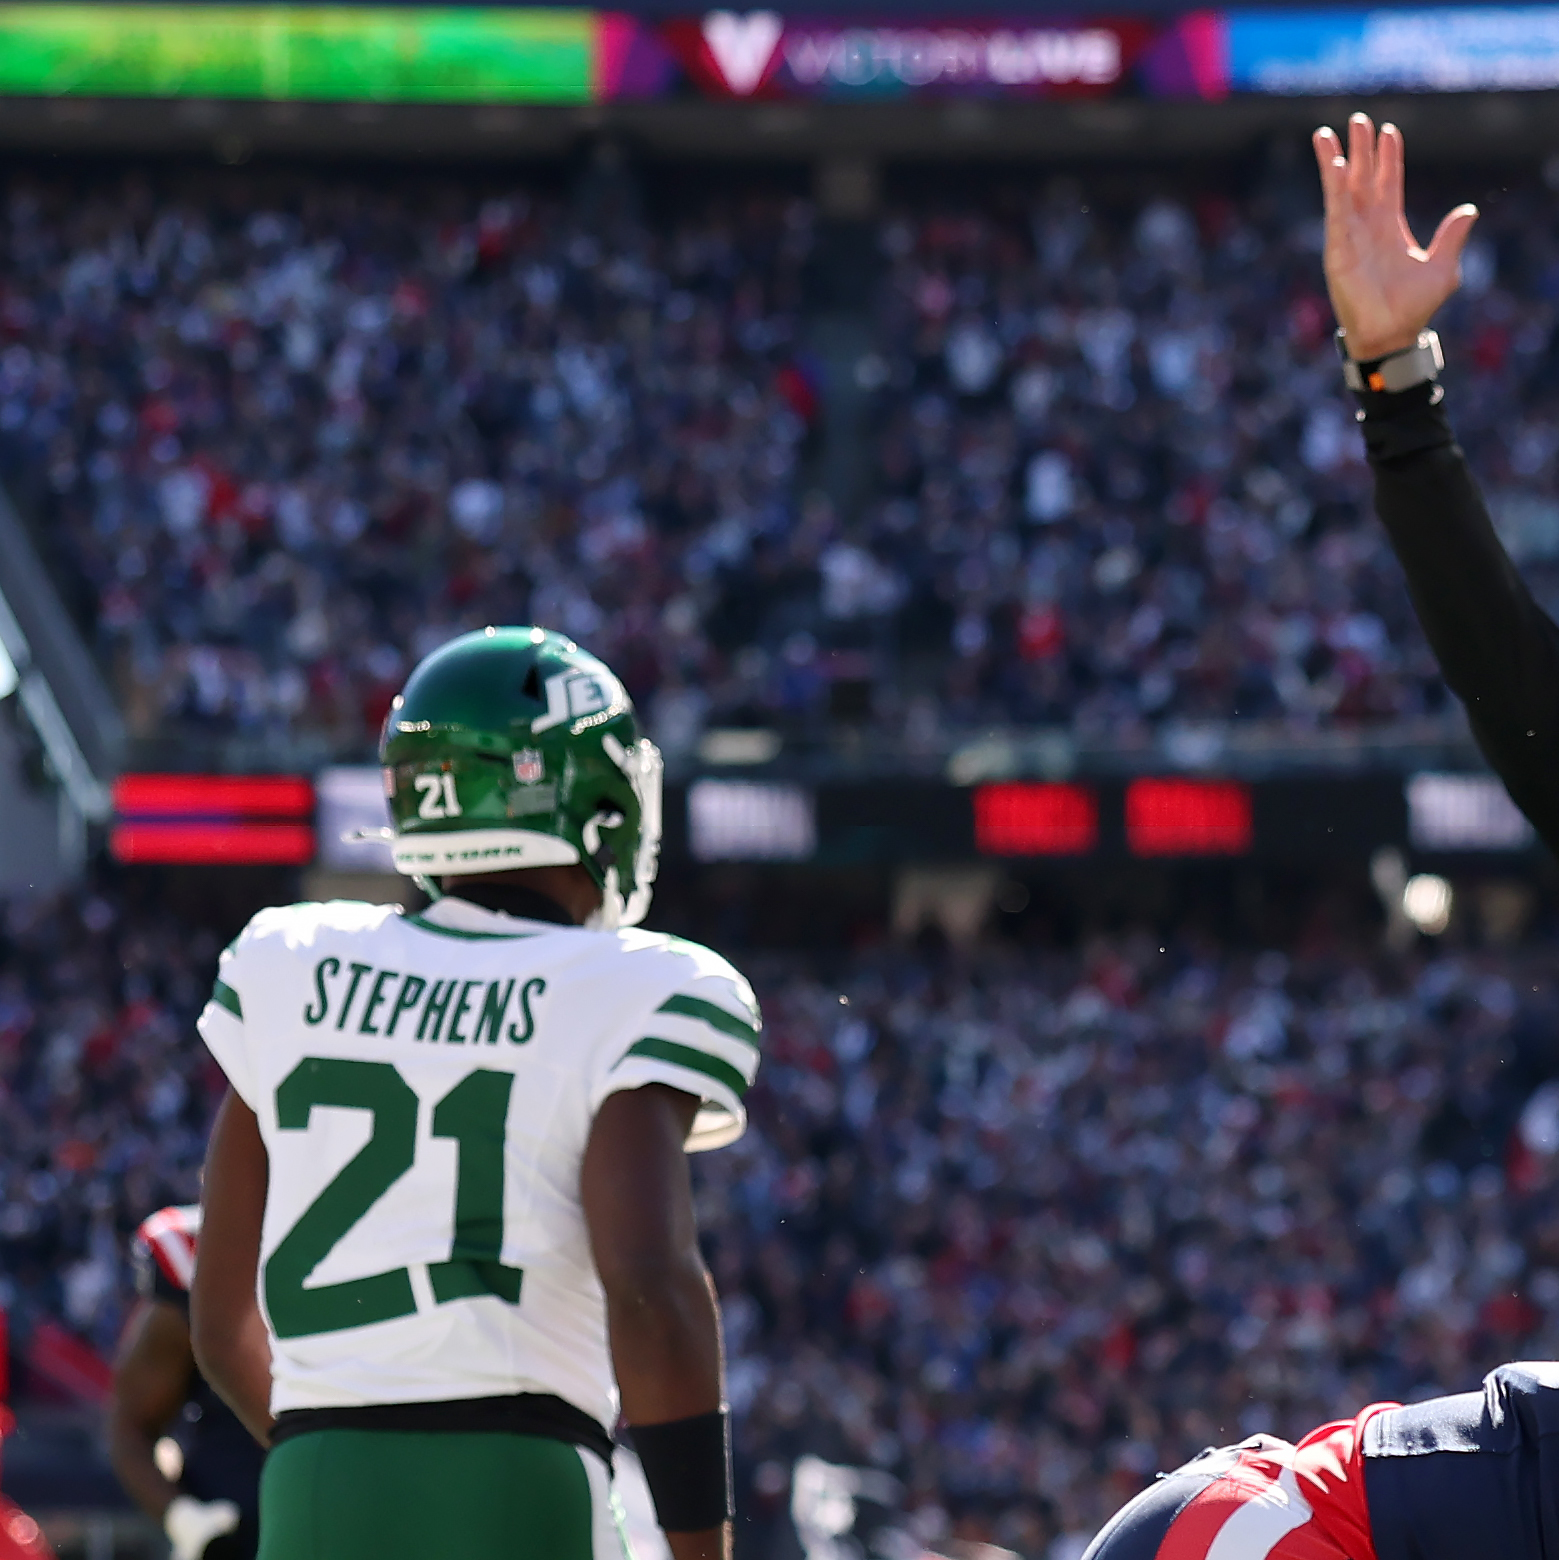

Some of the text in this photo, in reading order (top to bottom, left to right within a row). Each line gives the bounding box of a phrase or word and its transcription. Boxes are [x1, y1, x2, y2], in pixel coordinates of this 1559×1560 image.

[414, 772, 463, 820] 21
[303, 955, 549, 1047] STEPHENS
[264, 1056, 525, 1341] 21
